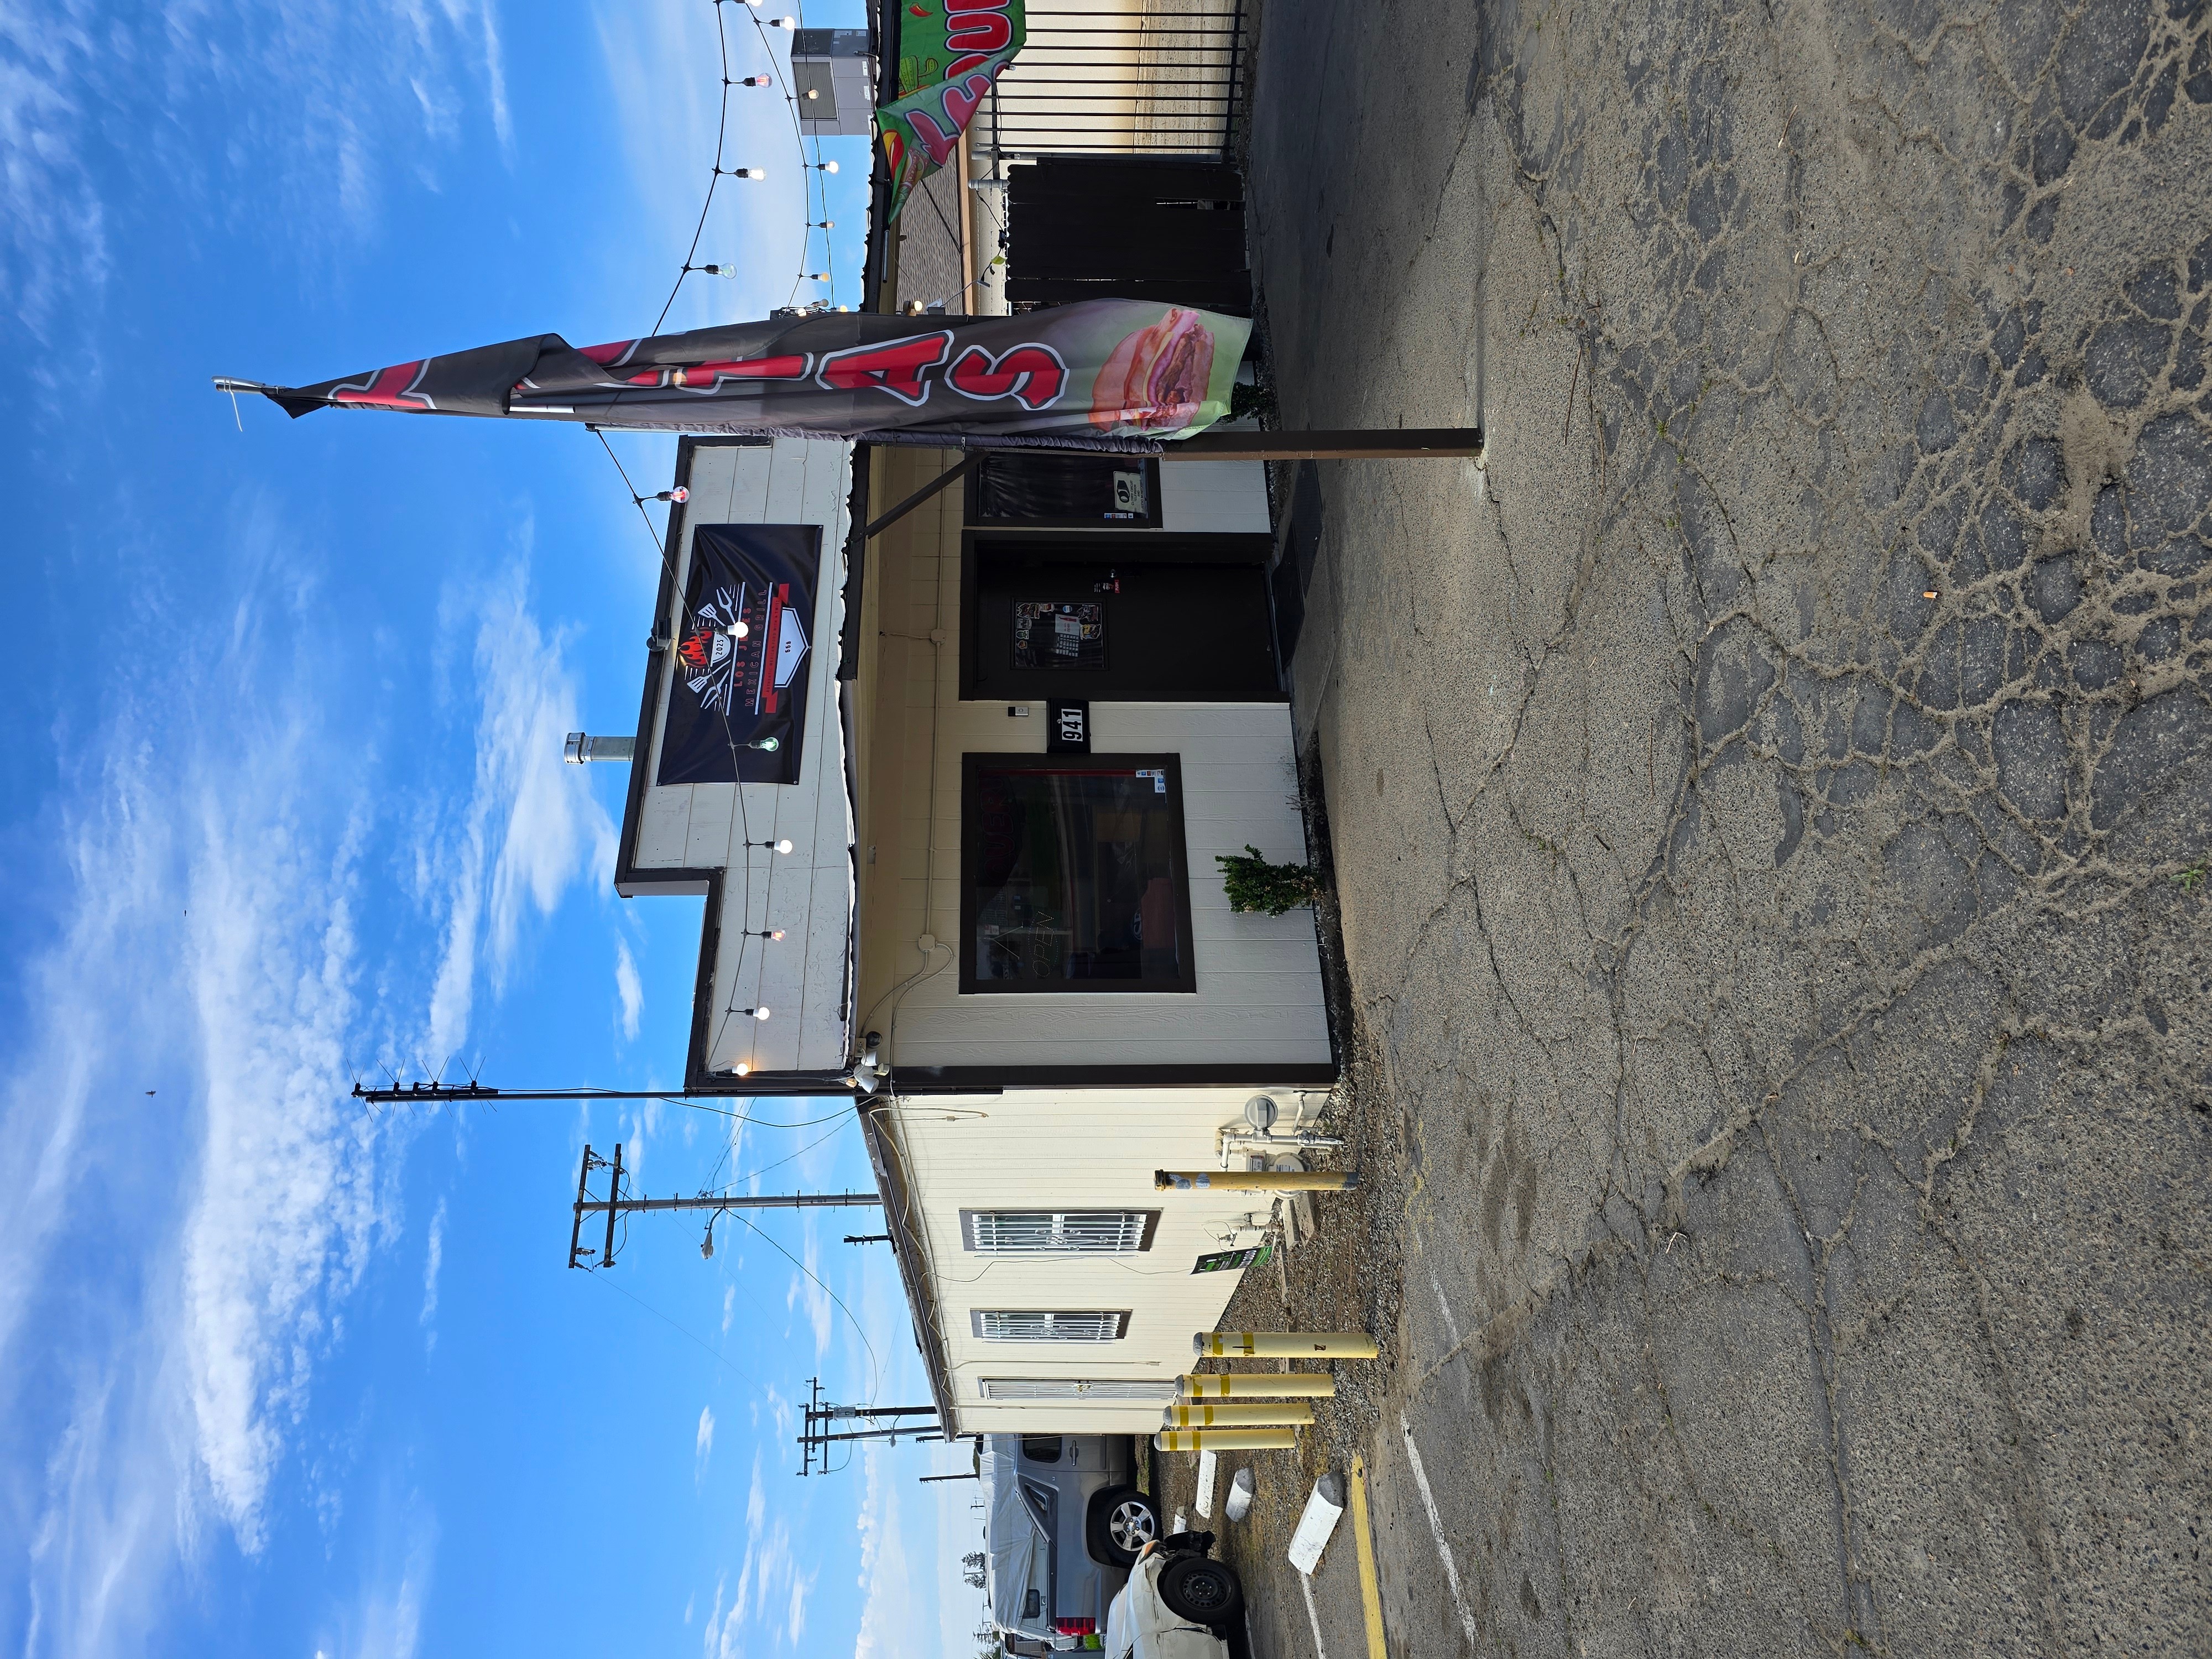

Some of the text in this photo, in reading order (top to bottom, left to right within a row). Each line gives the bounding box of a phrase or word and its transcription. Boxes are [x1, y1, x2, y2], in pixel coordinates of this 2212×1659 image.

[734, 607, 752, 687] LOS JEES
[745, 589, 766, 706] MEXICAN GRILL
[1062, 711, 1082, 740] 941
[1032, 911, 1055, 978] OPEN
